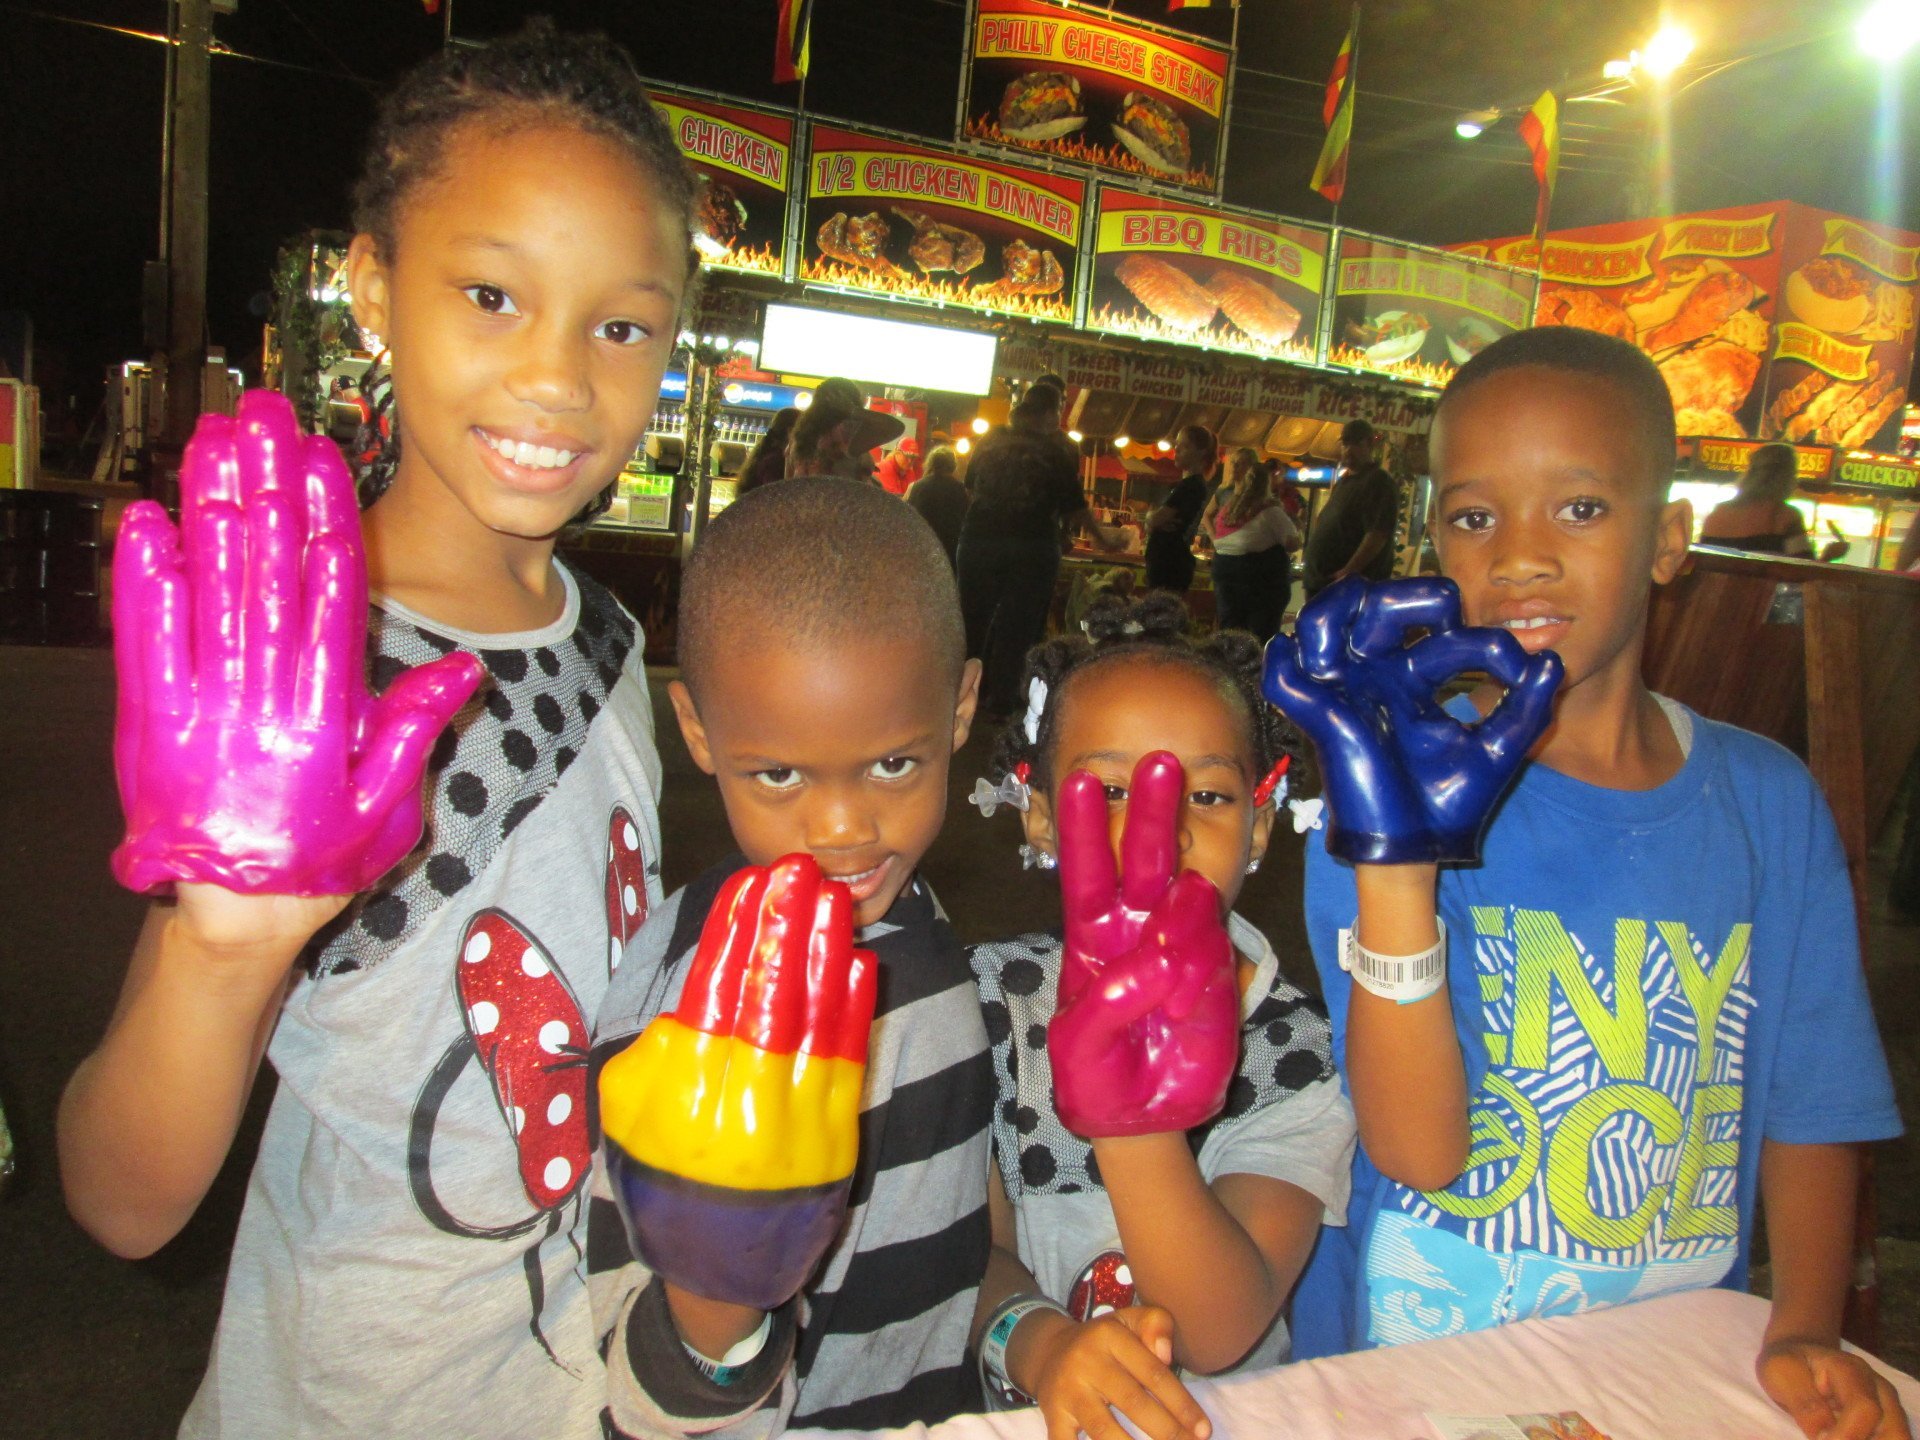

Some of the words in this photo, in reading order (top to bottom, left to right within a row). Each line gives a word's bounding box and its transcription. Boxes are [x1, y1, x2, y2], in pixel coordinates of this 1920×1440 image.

[981, 19, 1058, 55] PHILLY
[1062, 26, 1147, 78] CHEESE
[1151, 51, 1218, 110] STEAK
[680, 115, 783, 184] CHICKEN
[817, 154, 855, 195] 1/2
[864, 157, 979, 205] CHICKEN
[985, 177, 1075, 240] DINNER
[1121, 215, 1207, 254] BBQ
[1219, 224, 1303, 278] RIBS
[1541, 246, 1645, 279] CHICKEN
[1067, 370, 1121, 391] BURGER
[1132, 356, 1186, 380] PULLED
[1131, 378, 1184, 398] CHICKEN
[1199, 386, 1246, 407] SAUSAGE
[1258, 394, 1305, 415] SAUSAGE
[1316, 388, 1363, 418] RICE
[1840, 461, 1920, 489] CHICKEN
